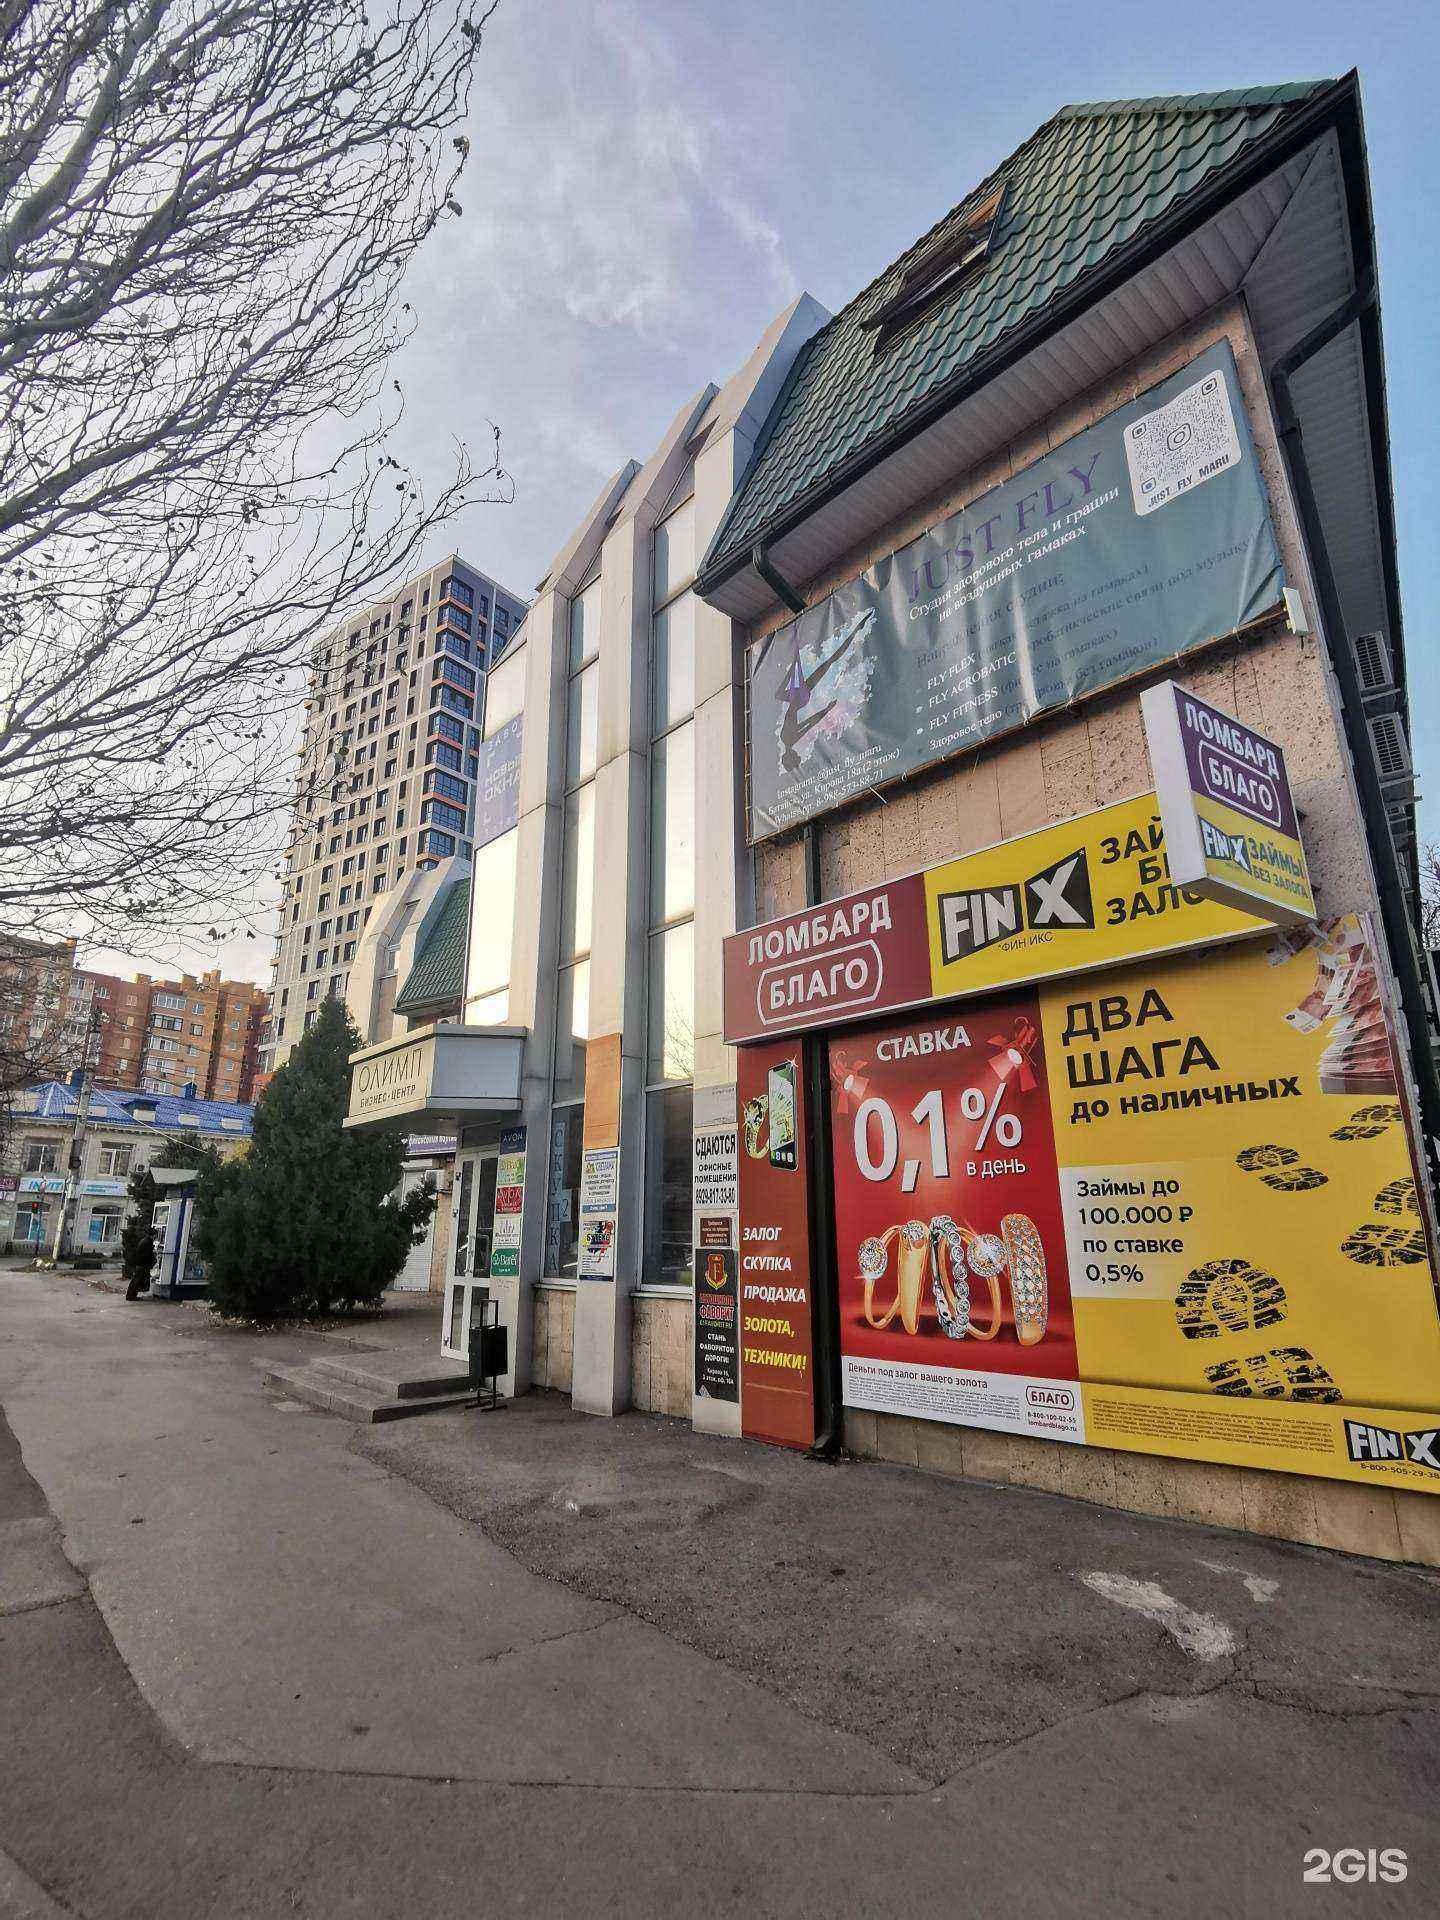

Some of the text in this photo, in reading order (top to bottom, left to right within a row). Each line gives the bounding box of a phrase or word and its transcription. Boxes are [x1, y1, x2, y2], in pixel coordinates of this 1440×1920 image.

[908, 452, 1103, 604] JUST FLY
[909, 486, 1120, 621] Студия здорового тела и грации
[939, 524, 1088, 624] на воздушных гамаках
[927, 670, 948, 690] FLY
[949, 652, 976, 679] FLEX
[928, 690, 949, 709] FLY
[951, 651, 1018, 697] ACROBATIC
[928, 711, 950, 731] FLY
[953, 686, 998, 721] FITNESS
[929, 720, 976, 751] Здоровое
[978, 710, 1003, 726] тело
[1185, 702, 1280, 780] ЛОМБАРД
[1208, 757, 1273, 811] БЛАГО
[1250, 838, 1305, 880] ЗАЙМЫ
[1253, 866, 1271, 884] БЕЗ
[747, 893, 893, 966] ЛОМБАРД
[1029, 931, 1054, 949] ИКС
[769, 957, 869, 1010] БЛАГО
[1061, 988, 1175, 1047] ДВА
[876, 1025, 971, 1061] СТАВКА
[358, 1048, 423, 1093] ОЛИМП
[1066, 1035, 1221, 1089] ШАГА
[1070, 1075, 1303, 1124] до наличных
[503, 1132, 523, 1143] AVON
[695, 1133, 736, 1161] СДАЮТСЯ
[694, 1173, 737, 1184] ПОМЕЩЕНИЯ
[698, 1162, 733, 1173] ОФИСНЫЕ
[966, 1157, 1026, 1178] в день
[1077, 1178, 1180, 1198] Займы до
[1078, 1205, 1173, 1226] 100.000
[743, 1227, 782, 1241] ЗАЛОГ
[1083, 1236, 1184, 1253] по ставке
[743, 1256, 792, 1271] СКУПКА
[1085, 1264, 1144, 1283] 0,5%
[744, 1286, 806, 1303] ПРОДАЖА
[699, 1305, 735, 1321] ФАВОРИТ
[707, 1333, 726, 1342] СТАНЬ
[744, 1317, 796, 1337] ЗОЛОТА,
[699, 1343, 735, 1354] ФАВОРИТОМ
[744, 1348, 807, 1370] ТЕХНИКИ!
[848, 1362, 989, 1389] Деньги под залог вашего золота
[1031, 1391, 1070, 1405] БЛАГО
